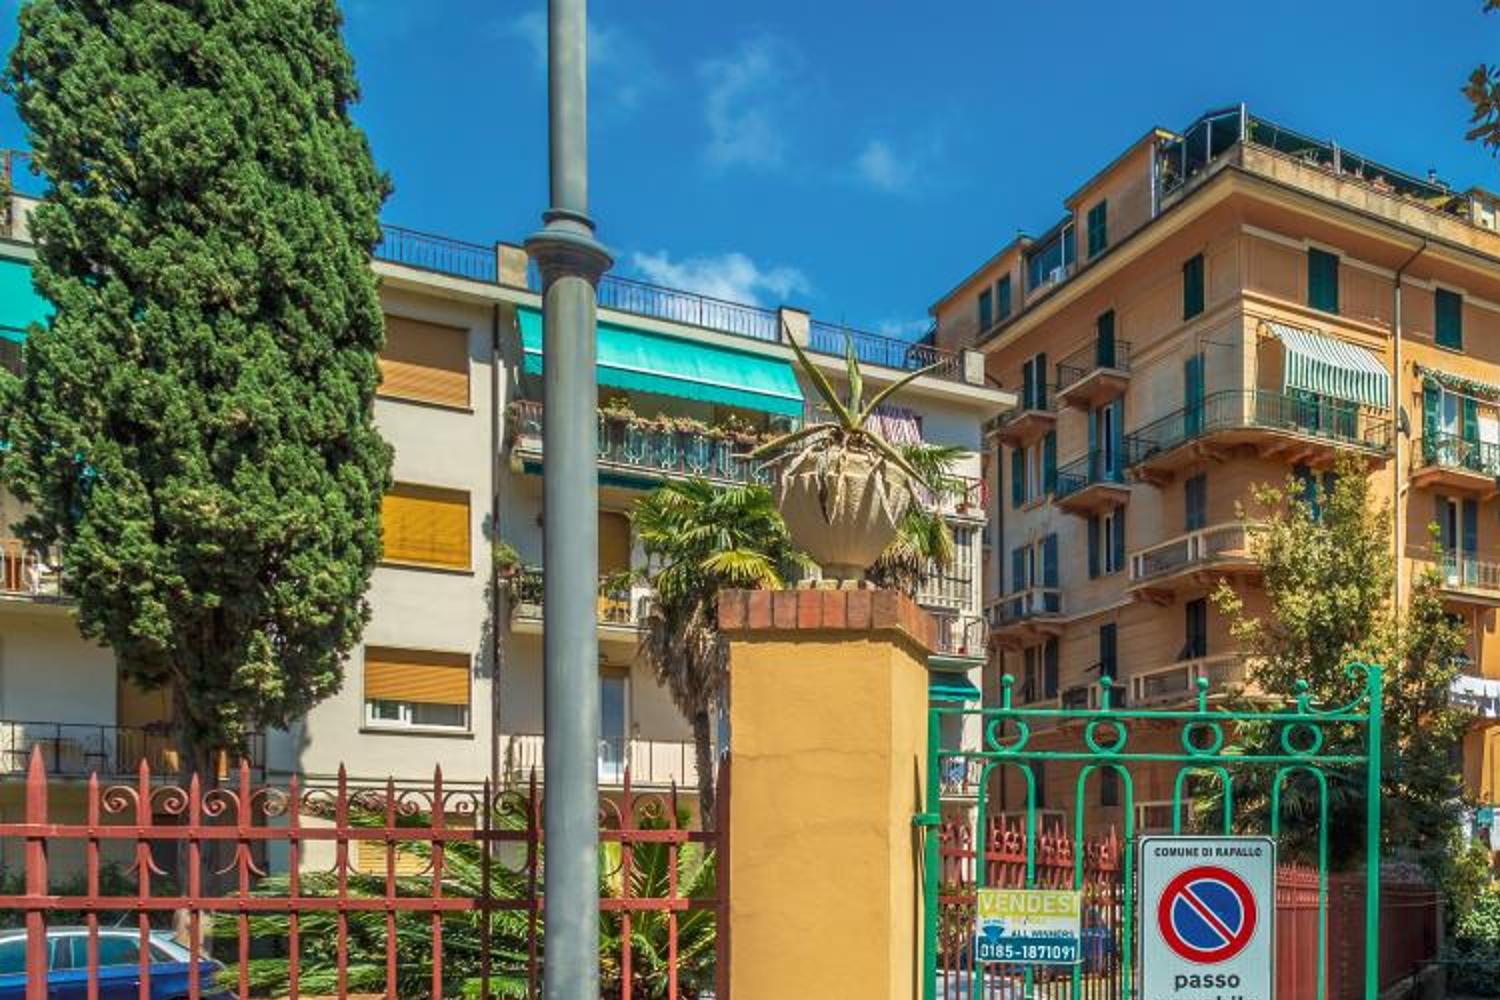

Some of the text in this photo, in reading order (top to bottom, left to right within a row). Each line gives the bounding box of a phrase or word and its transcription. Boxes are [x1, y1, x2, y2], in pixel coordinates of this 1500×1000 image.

[1154, 847, 1263, 857] COMUNE DI RAPALLO
[980, 893, 1079, 914] VENDESI
[981, 944, 1076, 960] 0185-1871091
[1174, 974, 1241, 992] passo
